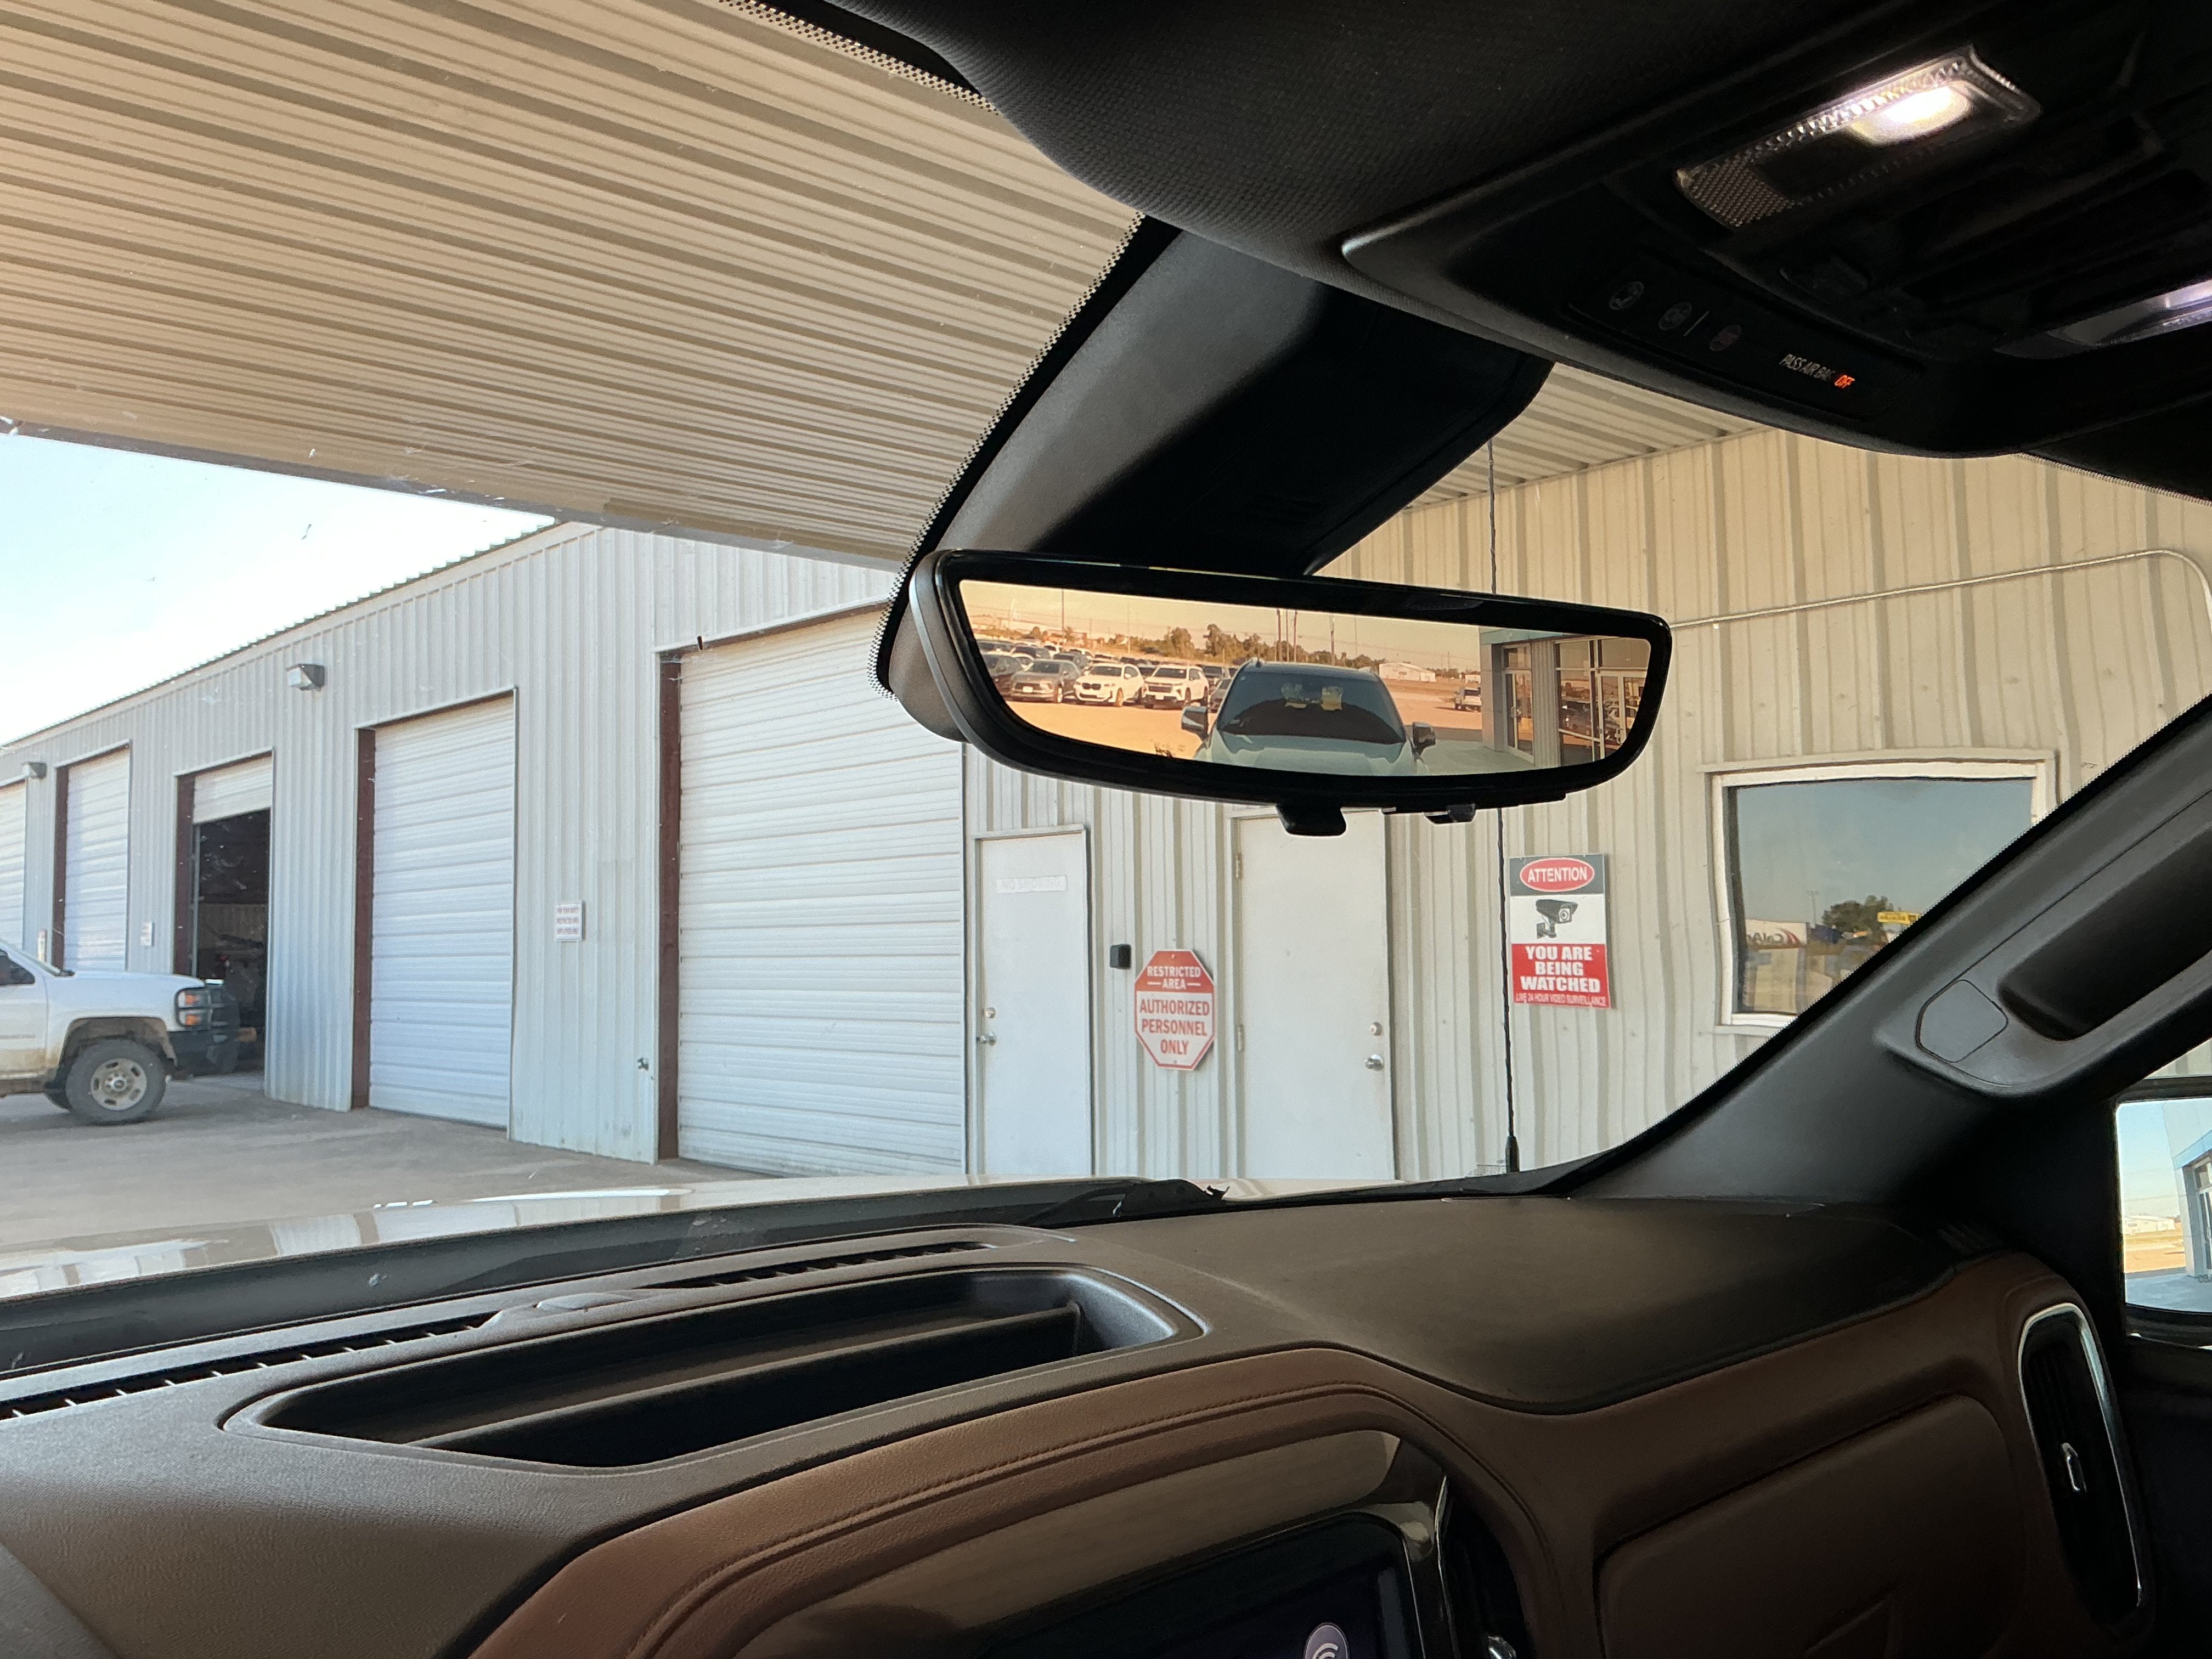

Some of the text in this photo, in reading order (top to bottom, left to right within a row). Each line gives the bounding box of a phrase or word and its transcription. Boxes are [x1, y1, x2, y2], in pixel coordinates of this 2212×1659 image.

[1779, 354, 1807, 371] PASS
[1798, 362, 1821, 376] AIR
[1835, 375, 1855, 389] OFF
[1527, 866, 1588, 883] ATTENTION
[1525, 946, 1593, 961] YOU ARE
[1147, 966, 1201, 978] RESTRICTED
[1535, 961, 1584, 976] BEING
[1161, 978, 1187, 990] AREA
[1520, 976, 1600, 992] WATCHED
[1140, 998, 1210, 1016] AUTHORIZED
[1142, 1018, 1207, 1036] PERSONNEL
[1160, 1039, 1189, 1055] ONLY
